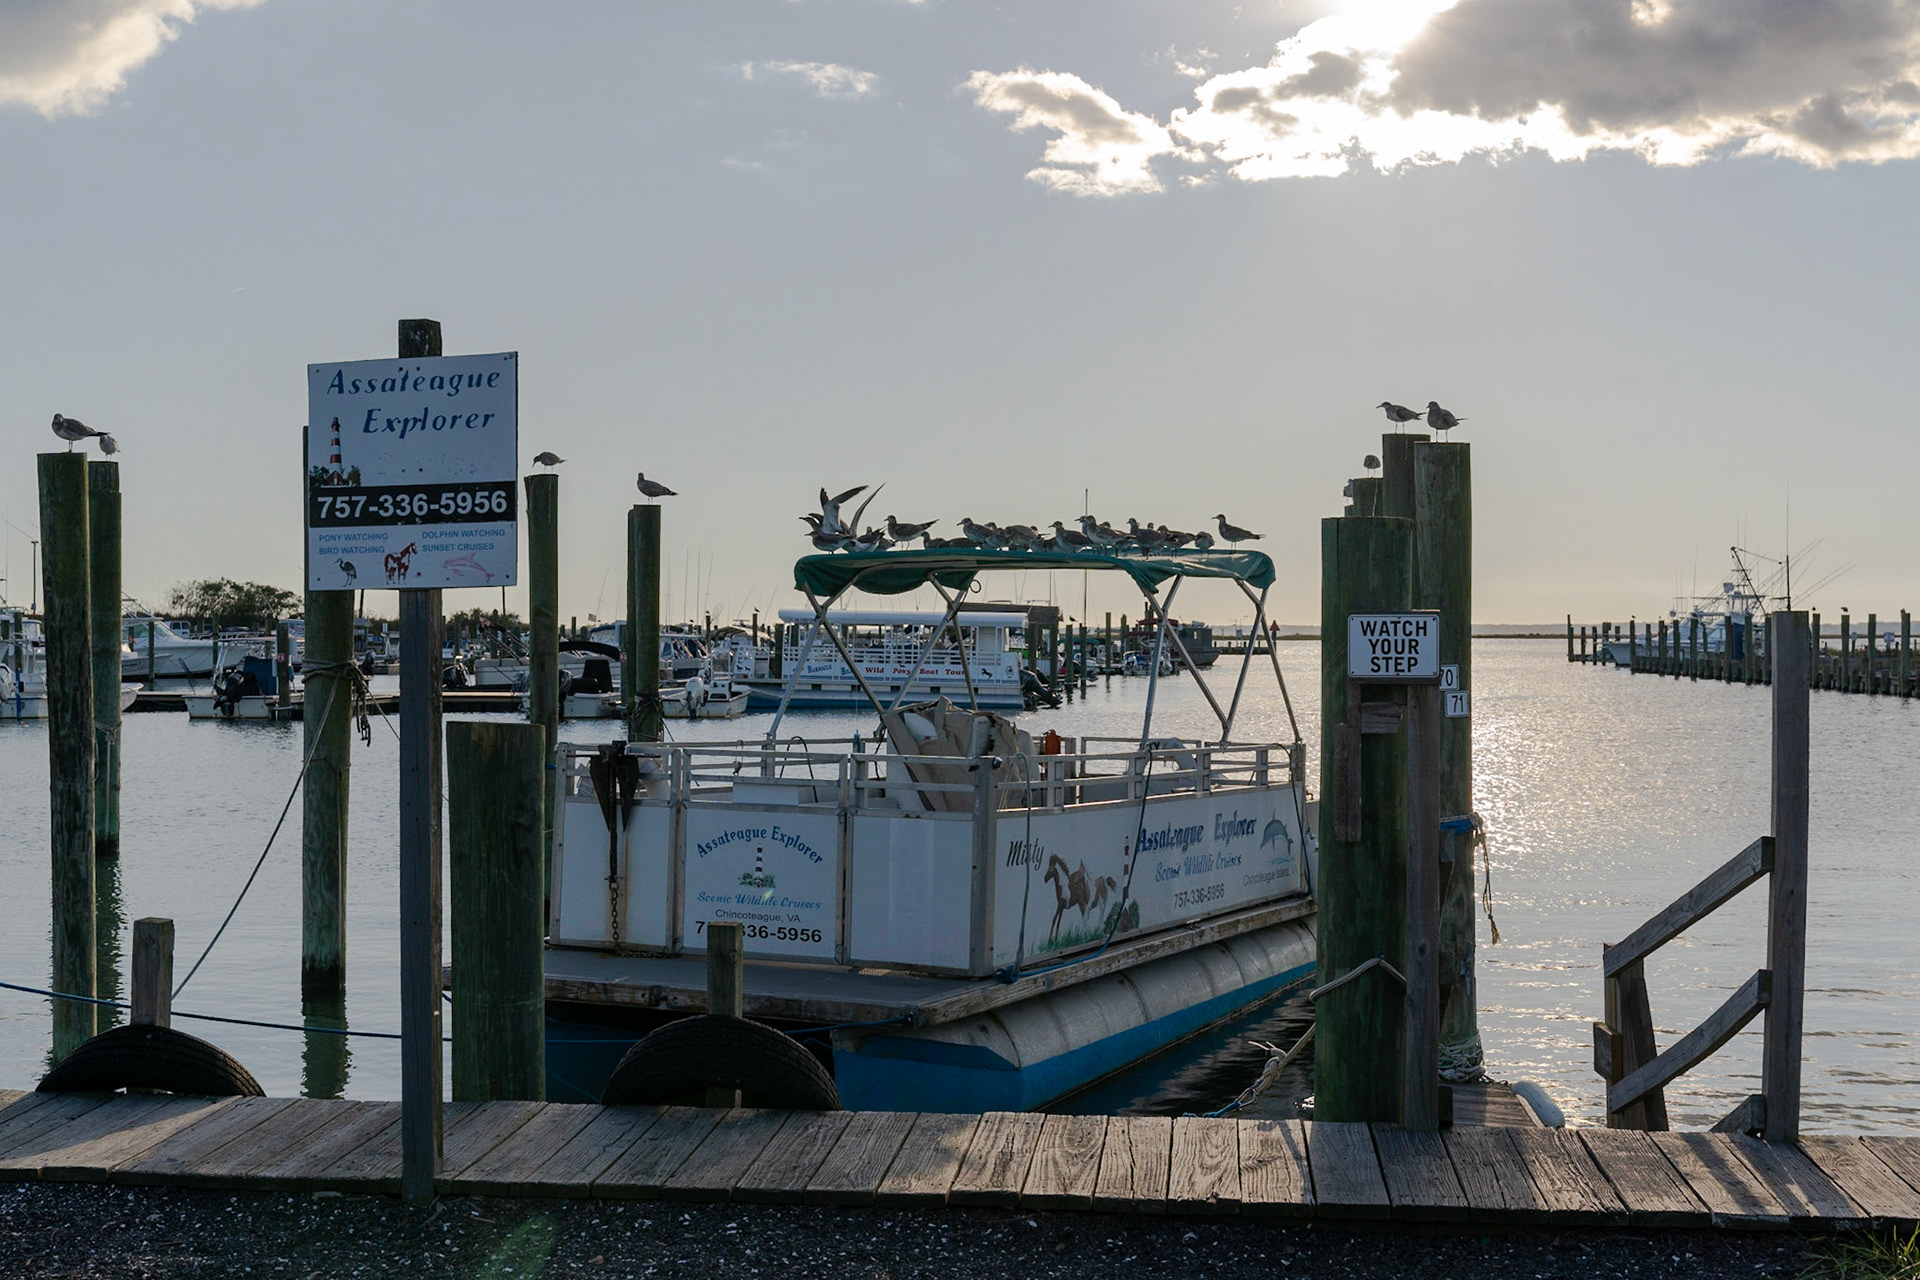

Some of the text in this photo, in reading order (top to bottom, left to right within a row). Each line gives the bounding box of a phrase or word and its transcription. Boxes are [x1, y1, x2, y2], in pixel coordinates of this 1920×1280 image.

[326, 369, 501, 397] Assateague
[362, 406, 495, 439] Explorer
[317, 490, 508, 519] 757-336-5956
[319, 532, 389, 542] PONY WATCHING
[422, 529, 506, 539] DOLPHIN WATCHING
[319, 545, 386, 555] BIRD WATCHING
[422, 542, 495, 551] SUNSET CRUISES
[1360, 620, 1427, 637] WATCH
[1368, 638, 1420, 655] YOUR
[1370, 656, 1418, 673] STEP
[1451, 695, 1464, 713] 71
[1138, 810, 1257, 853] Assateague Explorer
[697, 825, 823, 864] Assateague Explorer
[697, 891, 821, 910] Scenic Wildlife Cruises
[1174, 883, 1225, 909] 757-336-5956
[715, 909, 801, 923] Chincoteague, VA
